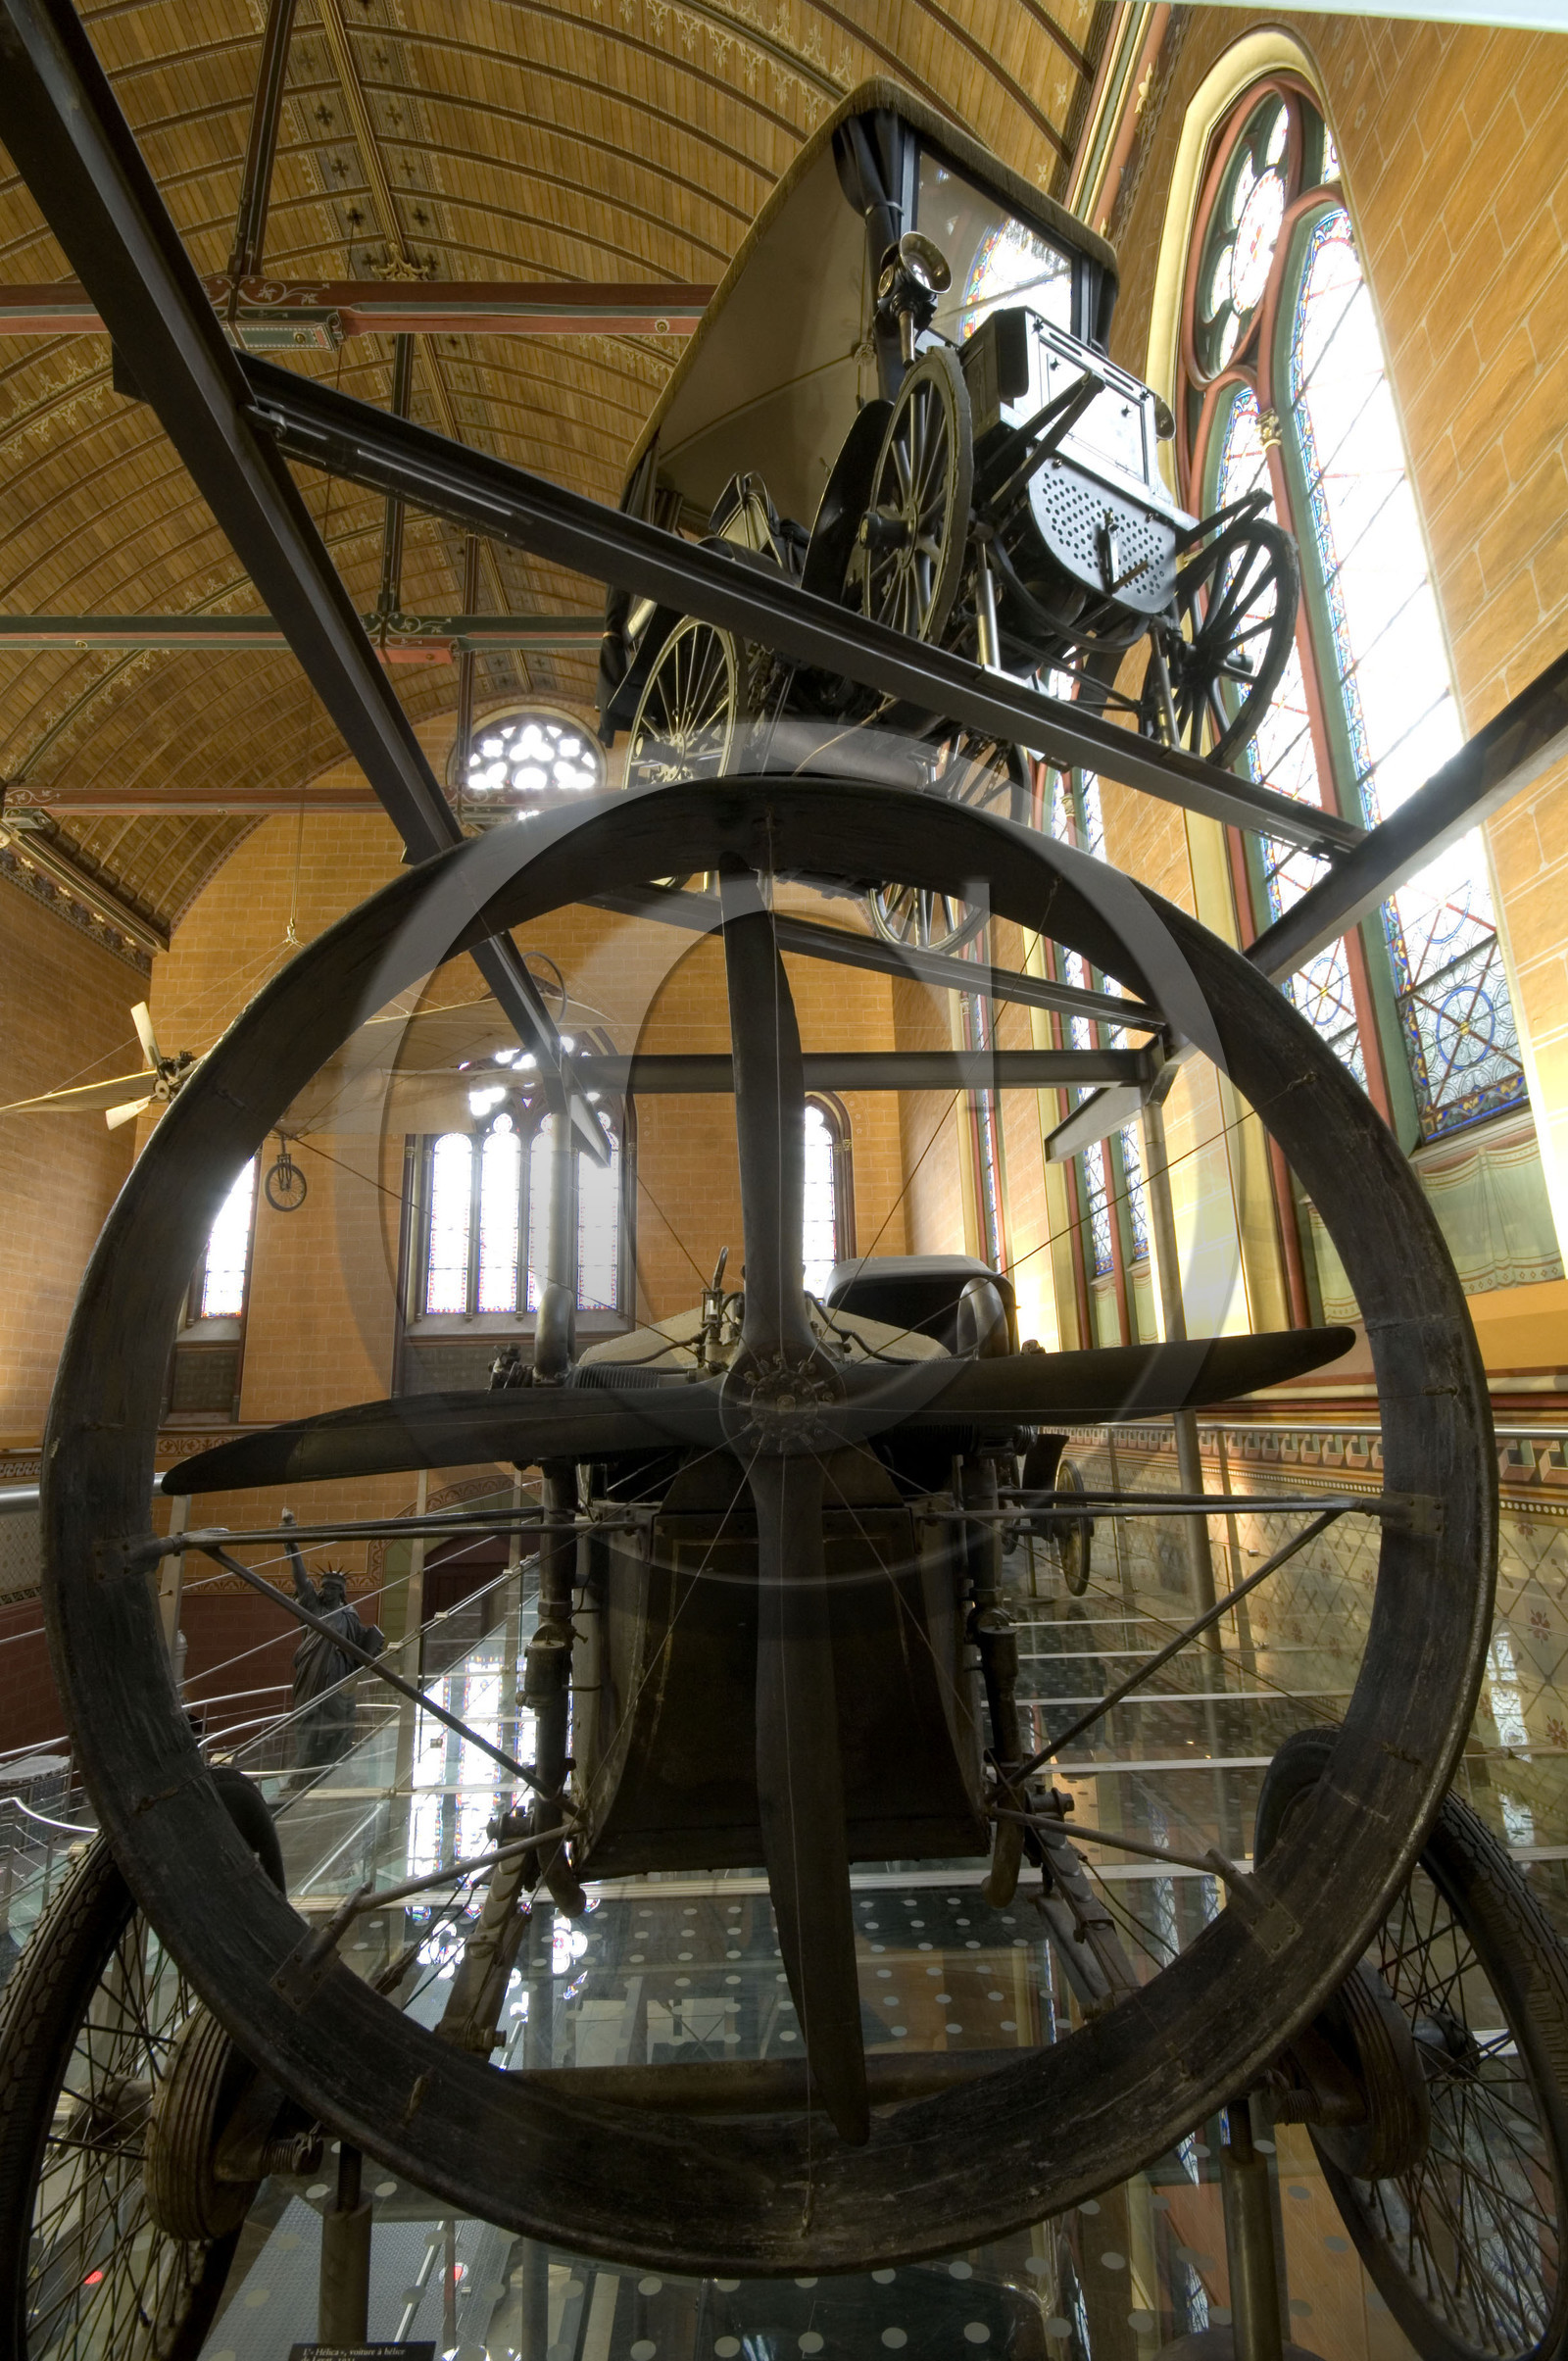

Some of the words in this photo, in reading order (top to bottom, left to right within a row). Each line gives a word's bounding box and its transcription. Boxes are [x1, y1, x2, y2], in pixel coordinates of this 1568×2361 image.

[315, 2347, 339, 2356] Hélica
[349, 2347, 376, 2356] voiture
[376, 2347, 382, 2356] à
[383, 2346, 406, 2356] hélice
